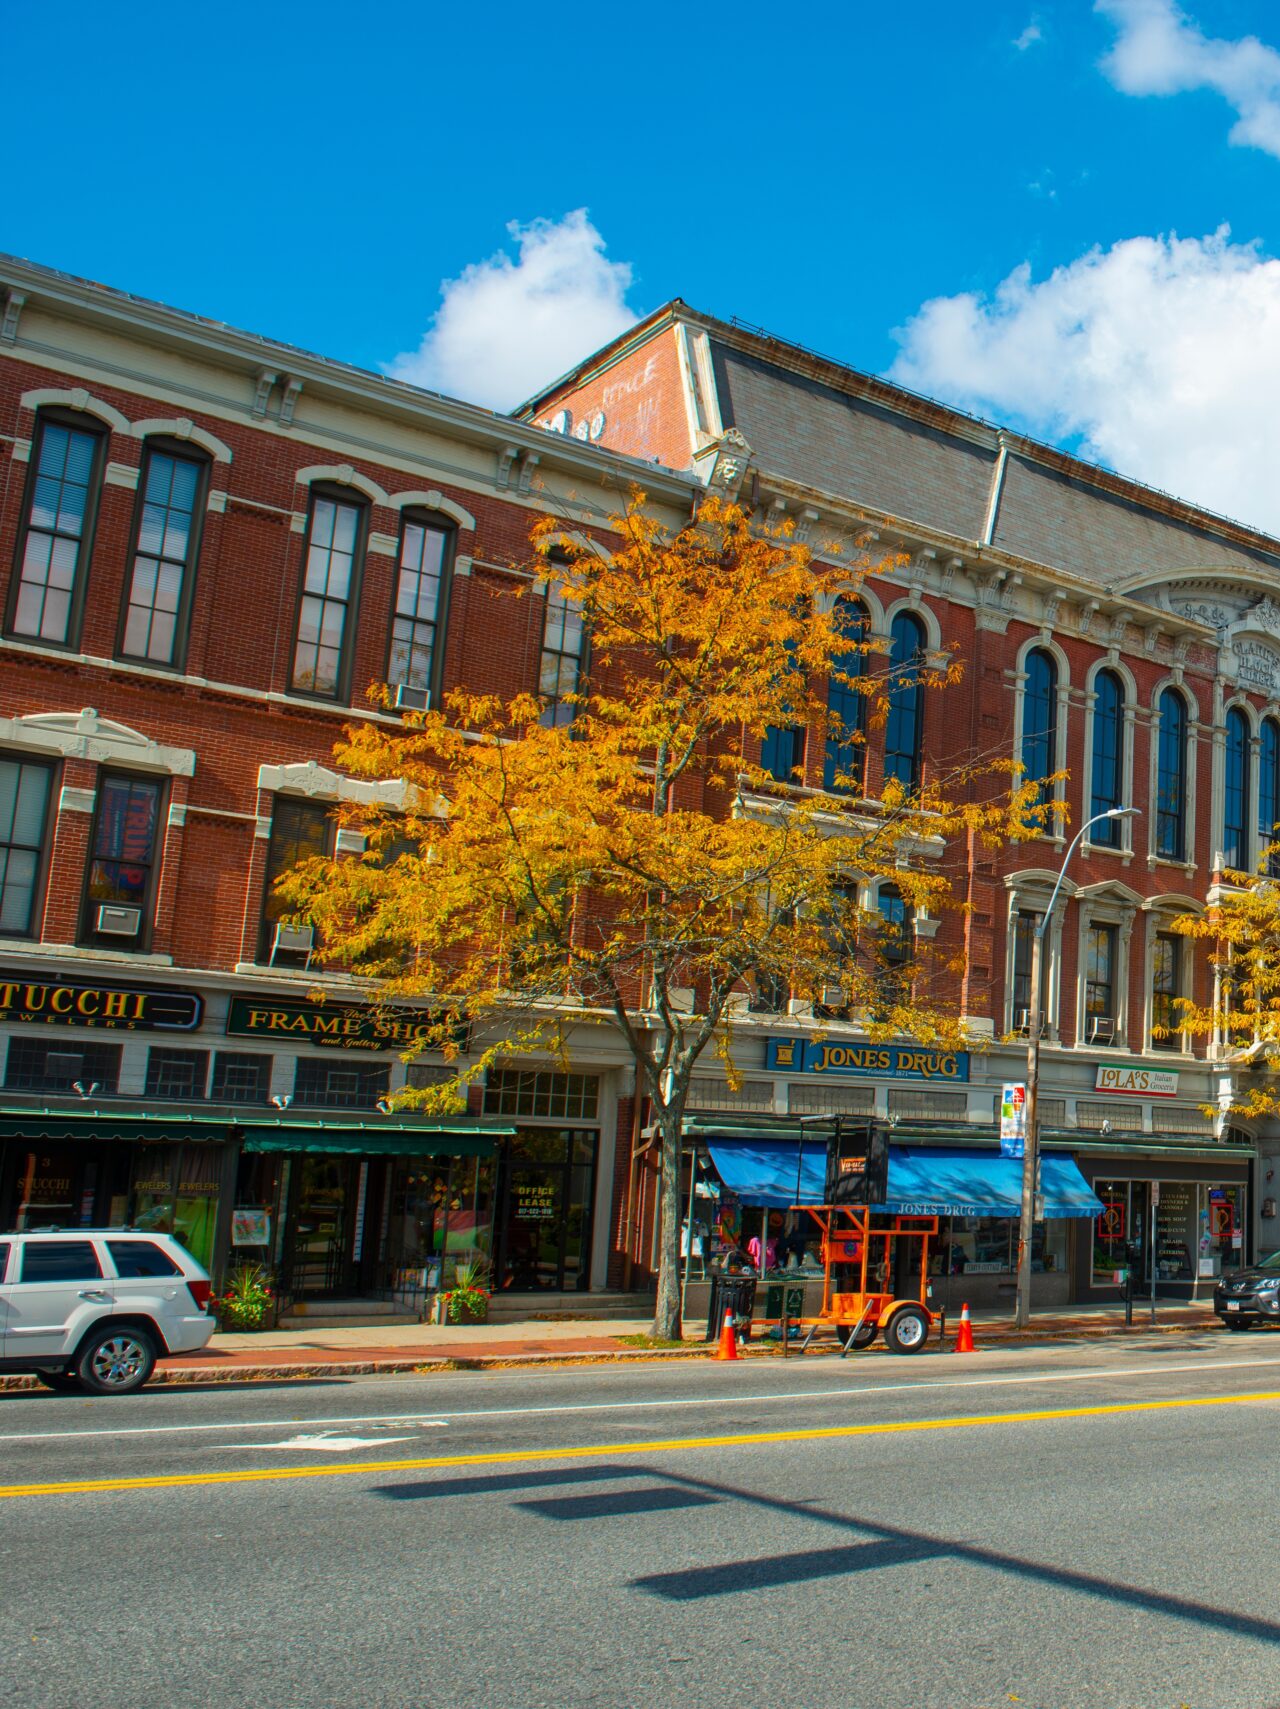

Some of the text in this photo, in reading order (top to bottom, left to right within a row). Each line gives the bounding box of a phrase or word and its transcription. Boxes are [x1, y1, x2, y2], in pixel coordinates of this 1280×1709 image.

[1238, 656, 1273, 677] BLOCK
[246, 1010, 455, 1042] FRAME SHO
[320, 1037, 382, 1050] and Gallery
[814, 1046, 959, 1078] JONES DRUG
[17, 1178, 70, 1190] SUCCHI
[134, 1181, 220, 1191] JEWELERS JEWELERS
[518, 1187, 555, 1195] OFFICE
[519, 1198, 553, 1207] LEASE
[898, 1203, 976, 1216] JONES DRUG
